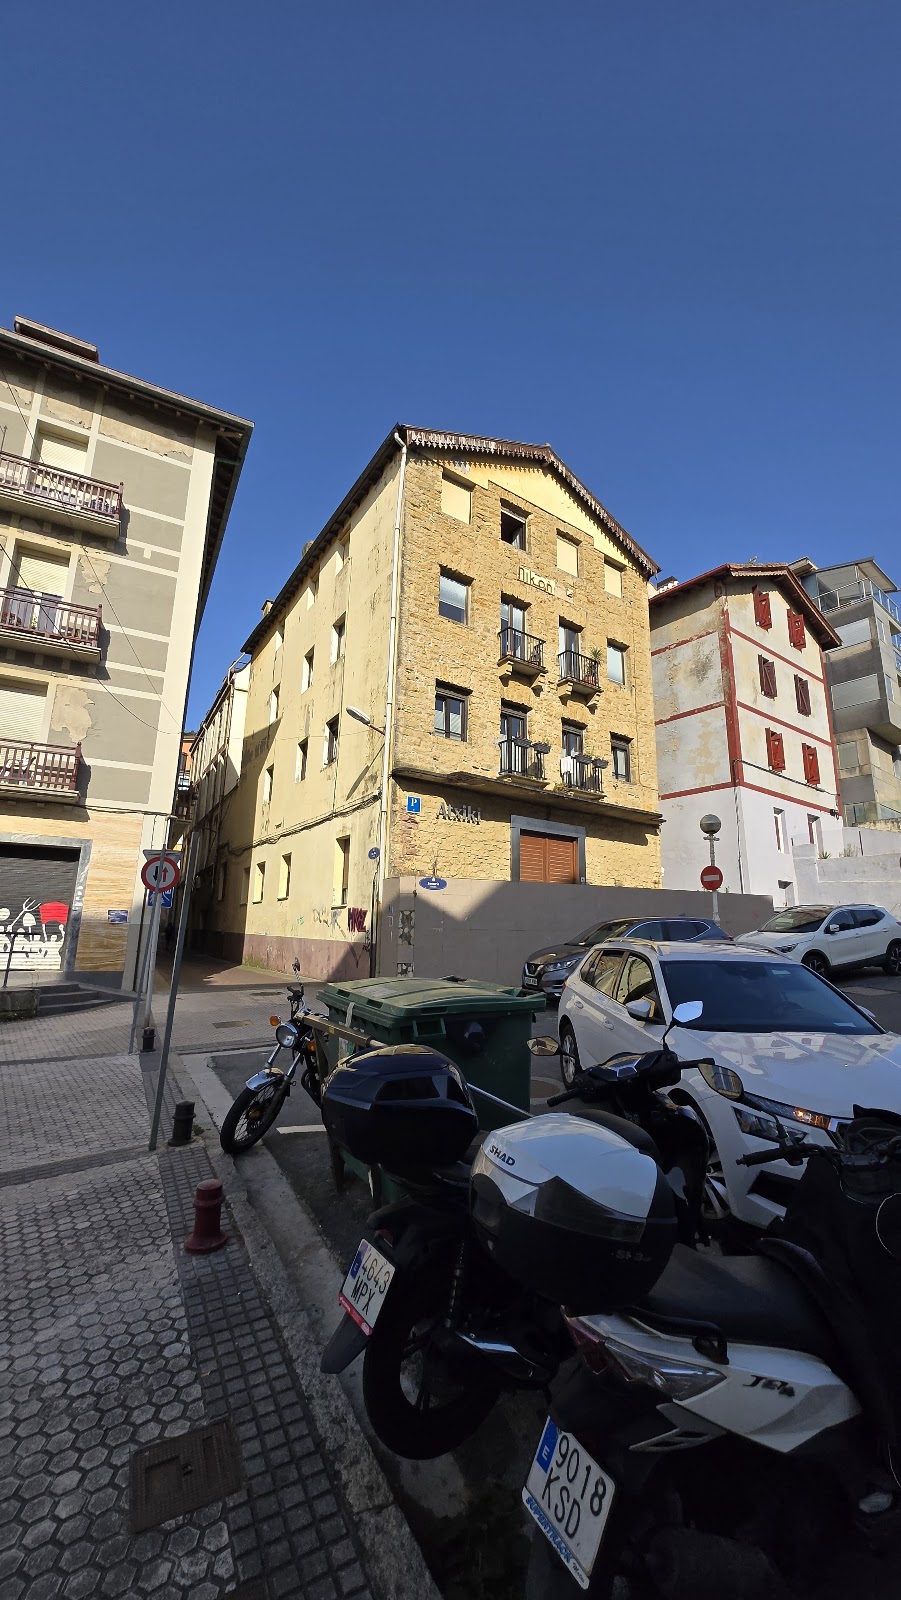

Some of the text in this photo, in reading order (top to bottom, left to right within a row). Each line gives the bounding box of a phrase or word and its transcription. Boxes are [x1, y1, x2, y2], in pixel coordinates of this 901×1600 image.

[410, 797, 418, 807] P
[437, 802, 481, 823] Atxiki
[489, 1144, 516, 1167] SHAD
[361, 1253, 391, 1295] 4643
[350, 1275, 376, 1316] MPX
[541, 1448, 550, 1461] E
[555, 1435, 607, 1517] 9018
[541, 1467, 581, 1539] KSD
[525, 1496, 574, 1563] SUPERTRACK
